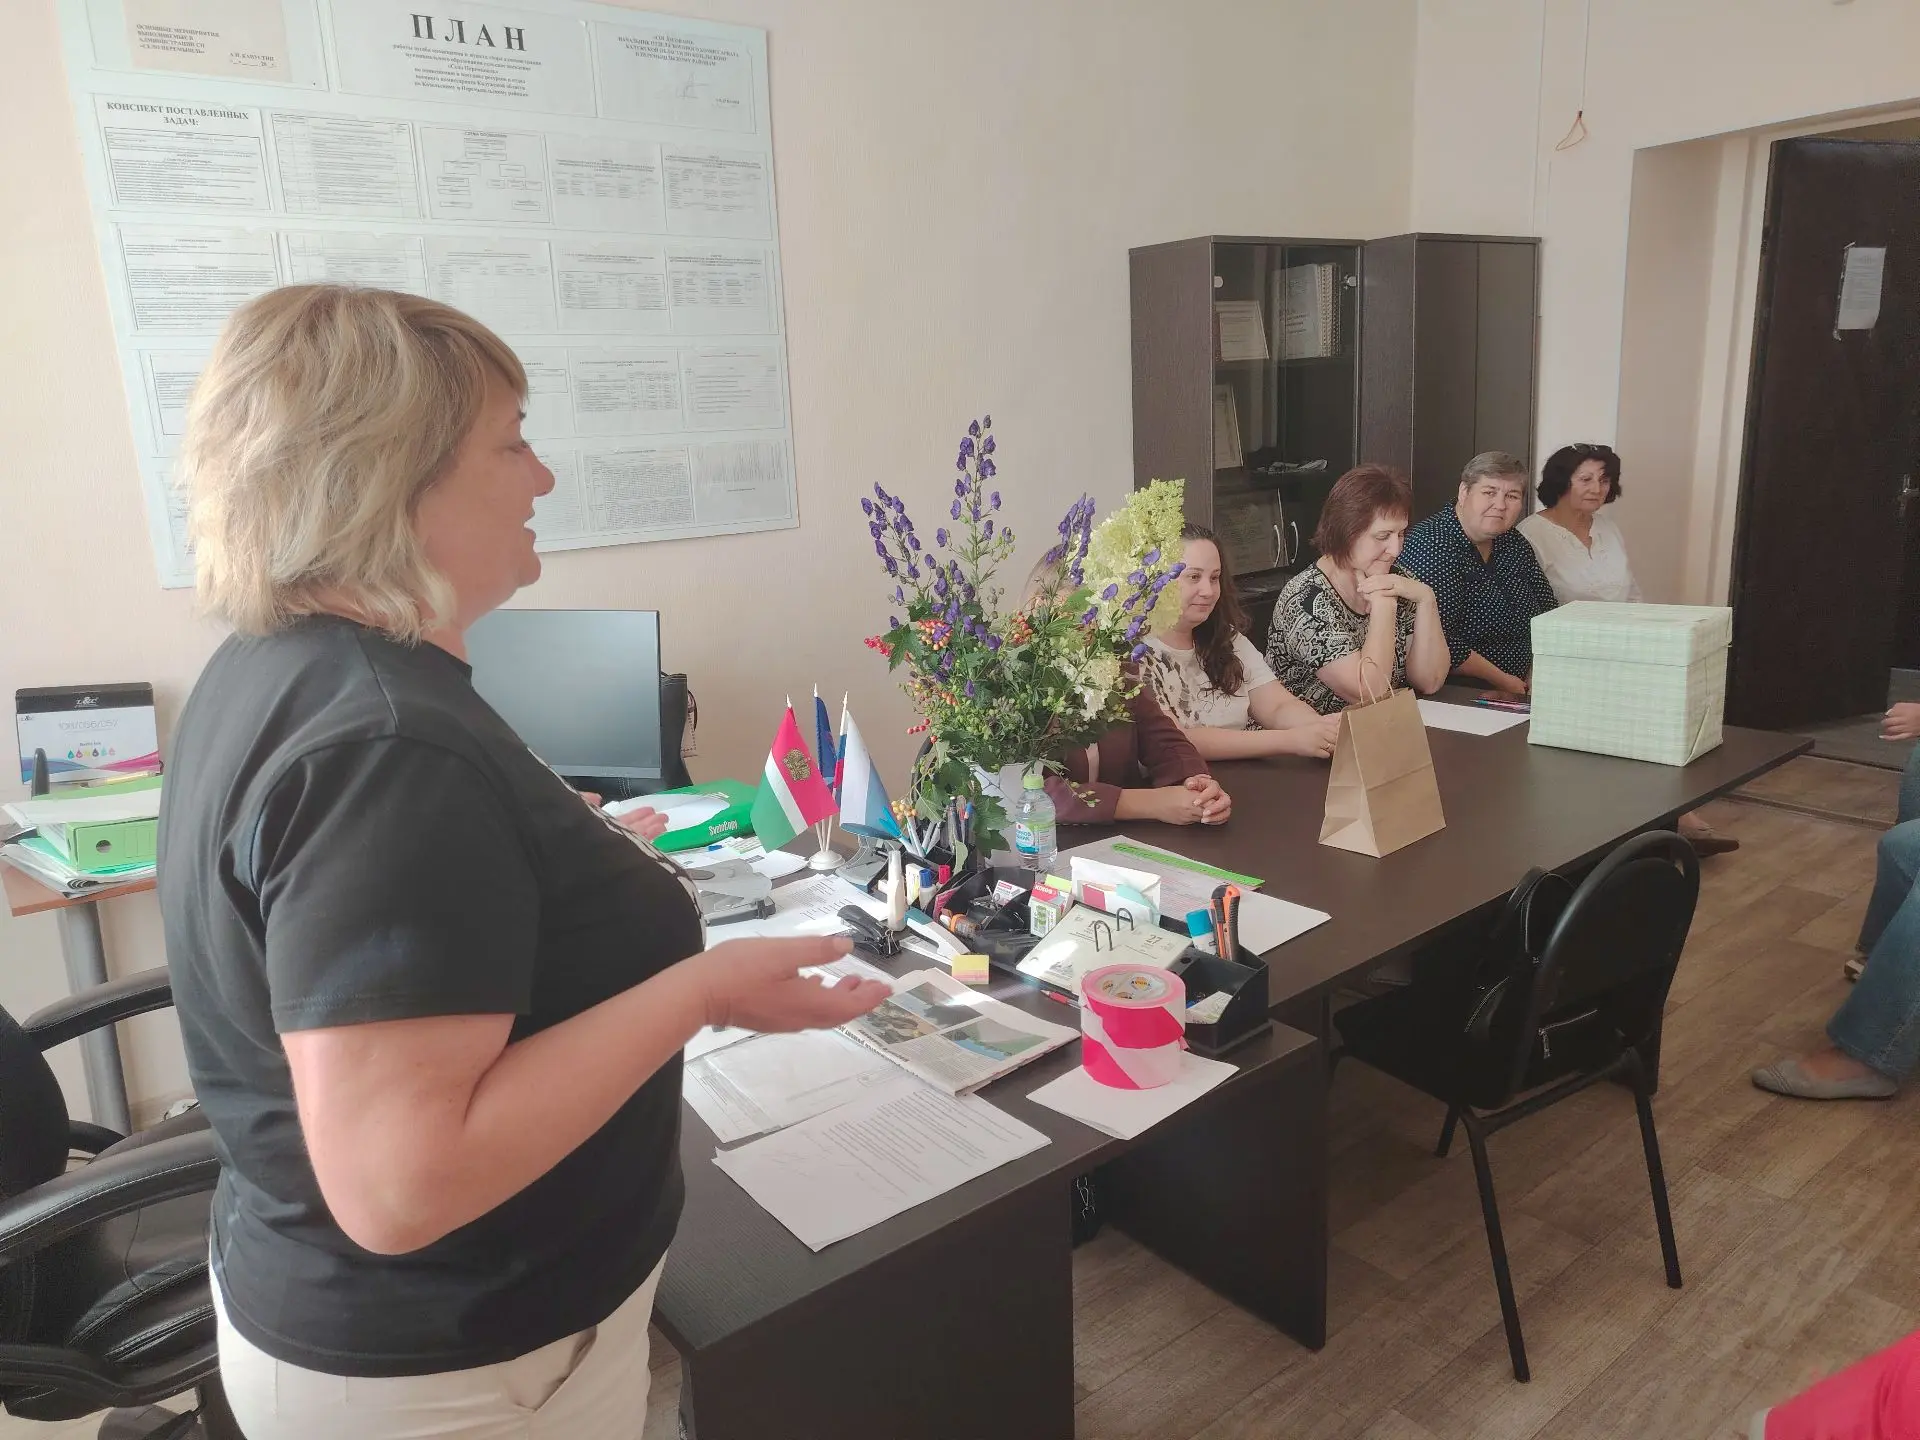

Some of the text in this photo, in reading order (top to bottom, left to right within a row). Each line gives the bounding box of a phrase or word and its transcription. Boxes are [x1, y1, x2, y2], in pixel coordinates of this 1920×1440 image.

[410, 13, 527, 51] ПЛАН
[106, 102, 249, 120] КОНСПЕКТ ПОСТАВЛЕННЫХ
[163, 116, 199, 126] ЗАДАЧ:
[1146, 934, 1163, 945] 27
